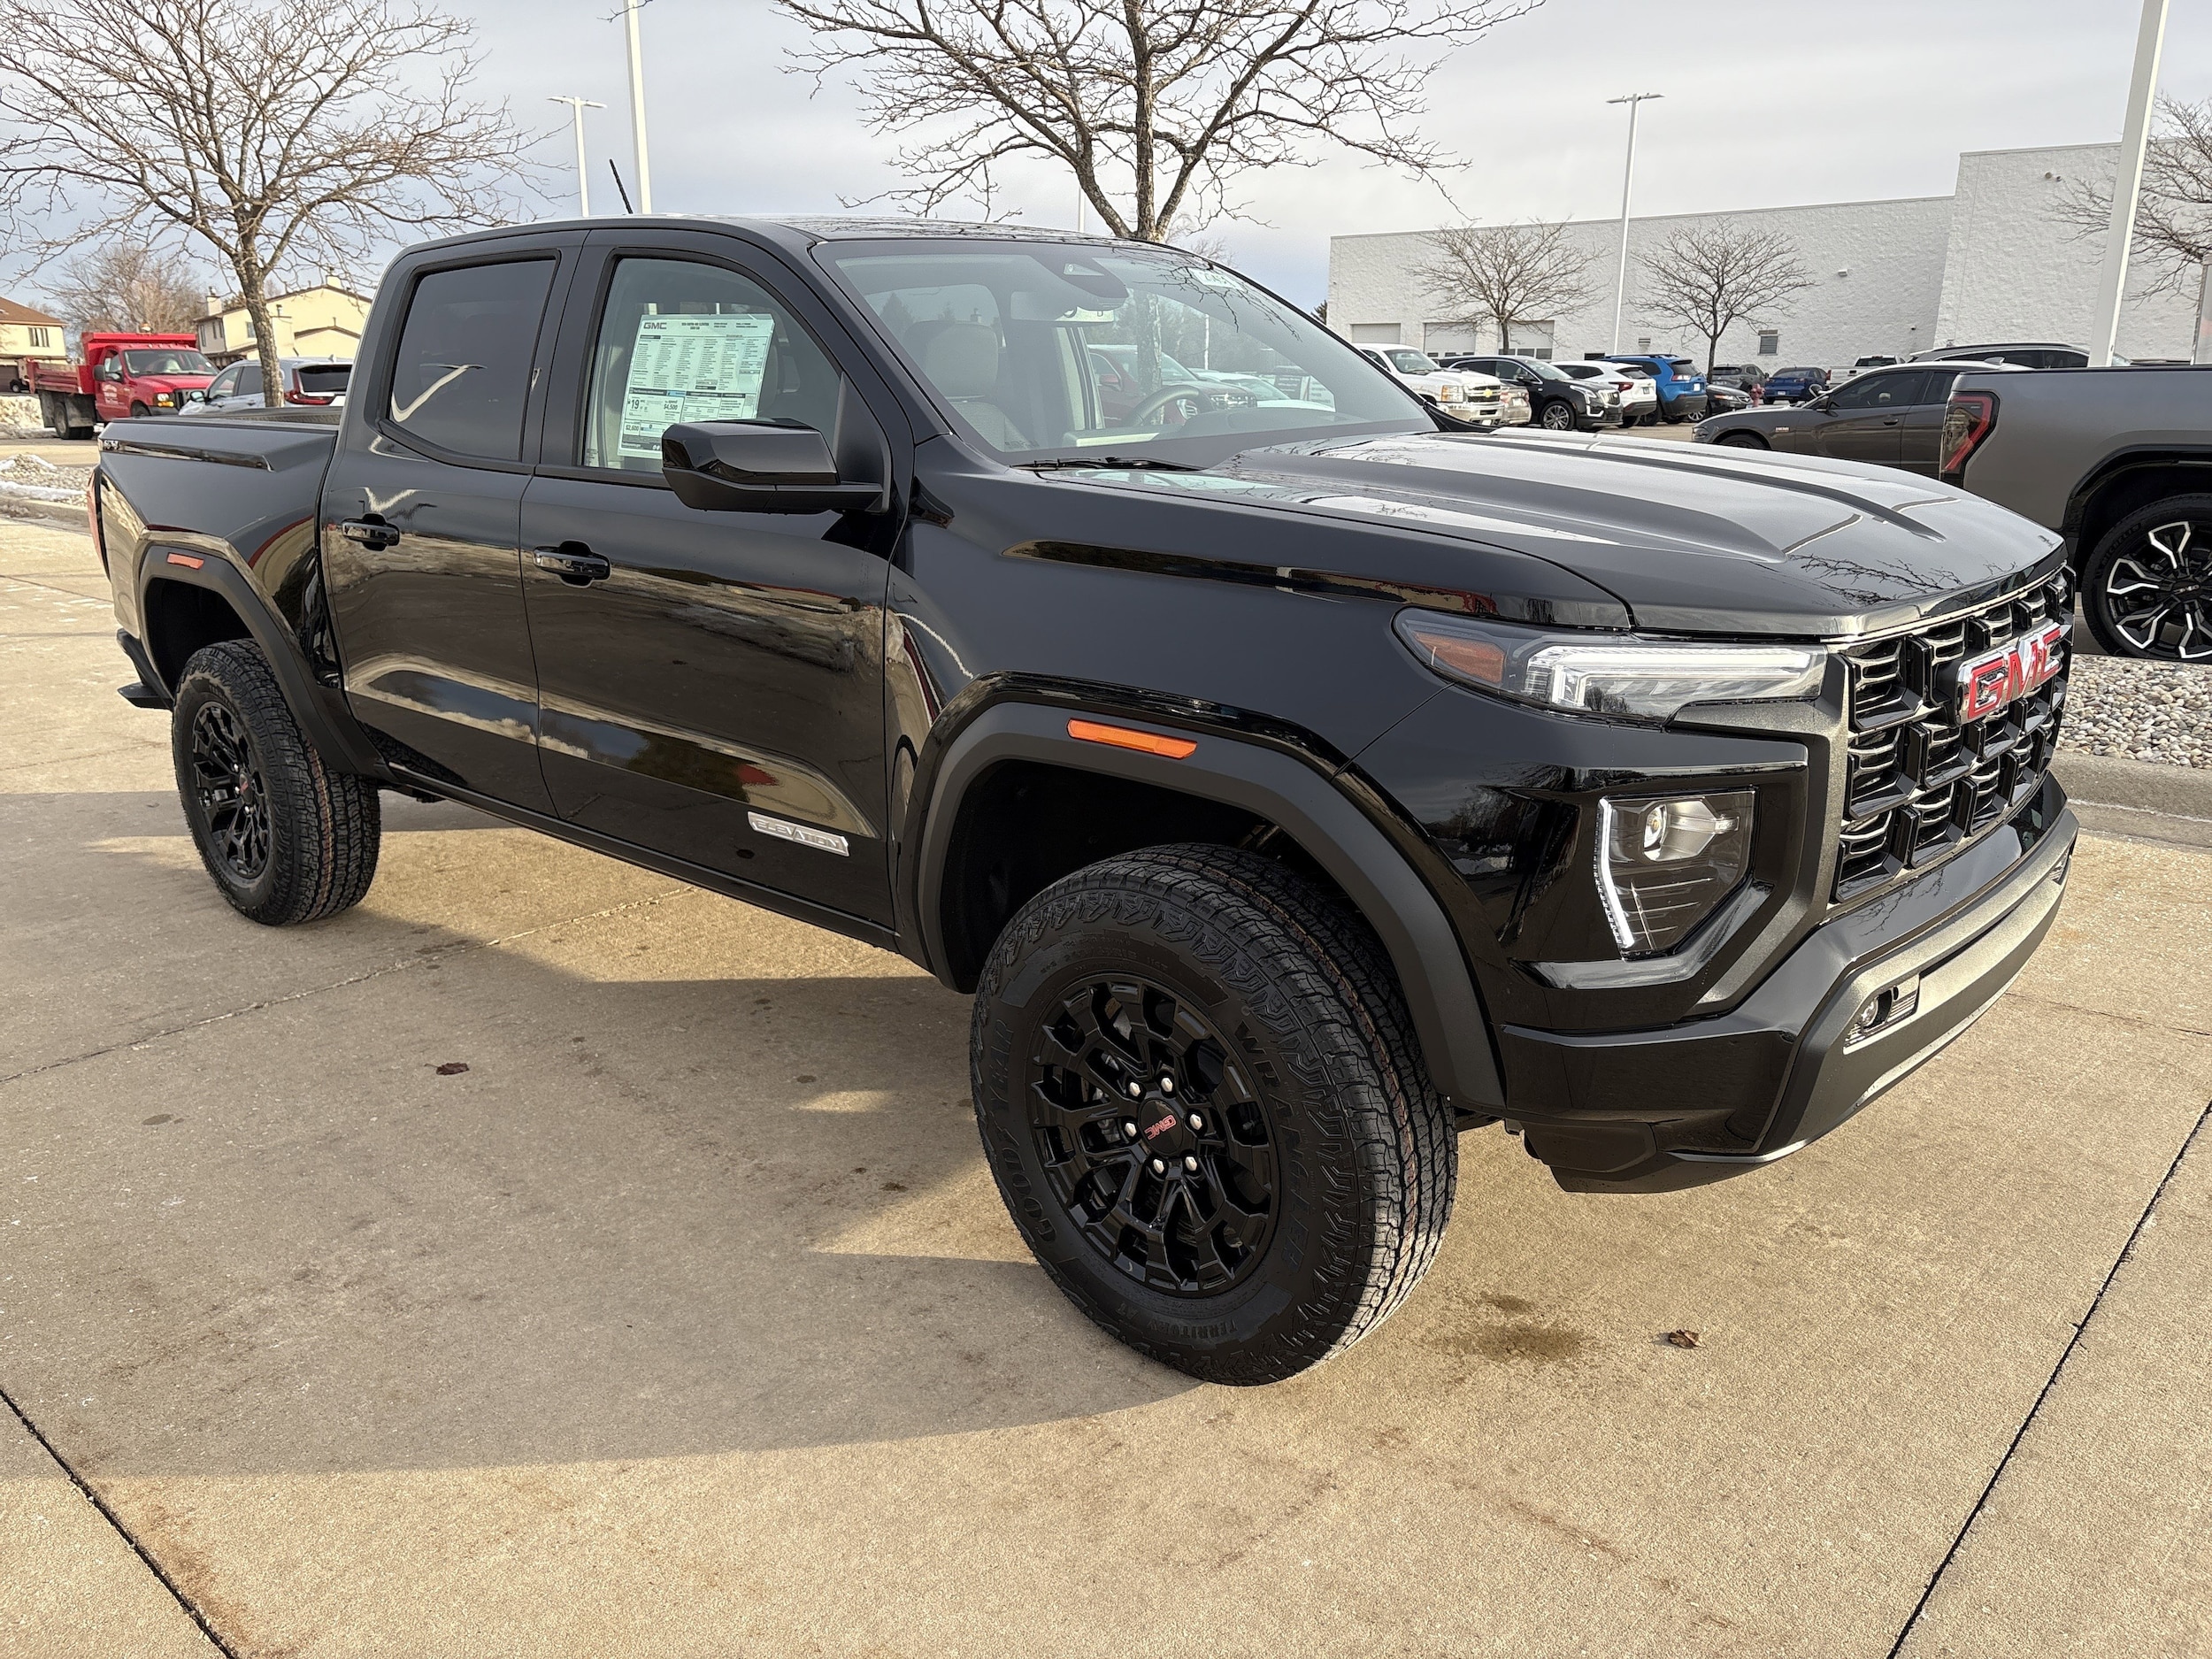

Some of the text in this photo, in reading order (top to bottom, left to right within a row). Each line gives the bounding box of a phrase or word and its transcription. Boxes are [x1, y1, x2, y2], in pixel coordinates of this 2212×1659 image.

[631, 399, 640, 410] 19
[1961, 623, 2062, 722] GMC
[757, 818, 840, 849] ELEVATION
[1143, 1114, 1177, 1141] GMC
[1233, 1018, 1310, 1275] WRANGLER
[1147, 1317, 1240, 1340] TERRITORY
